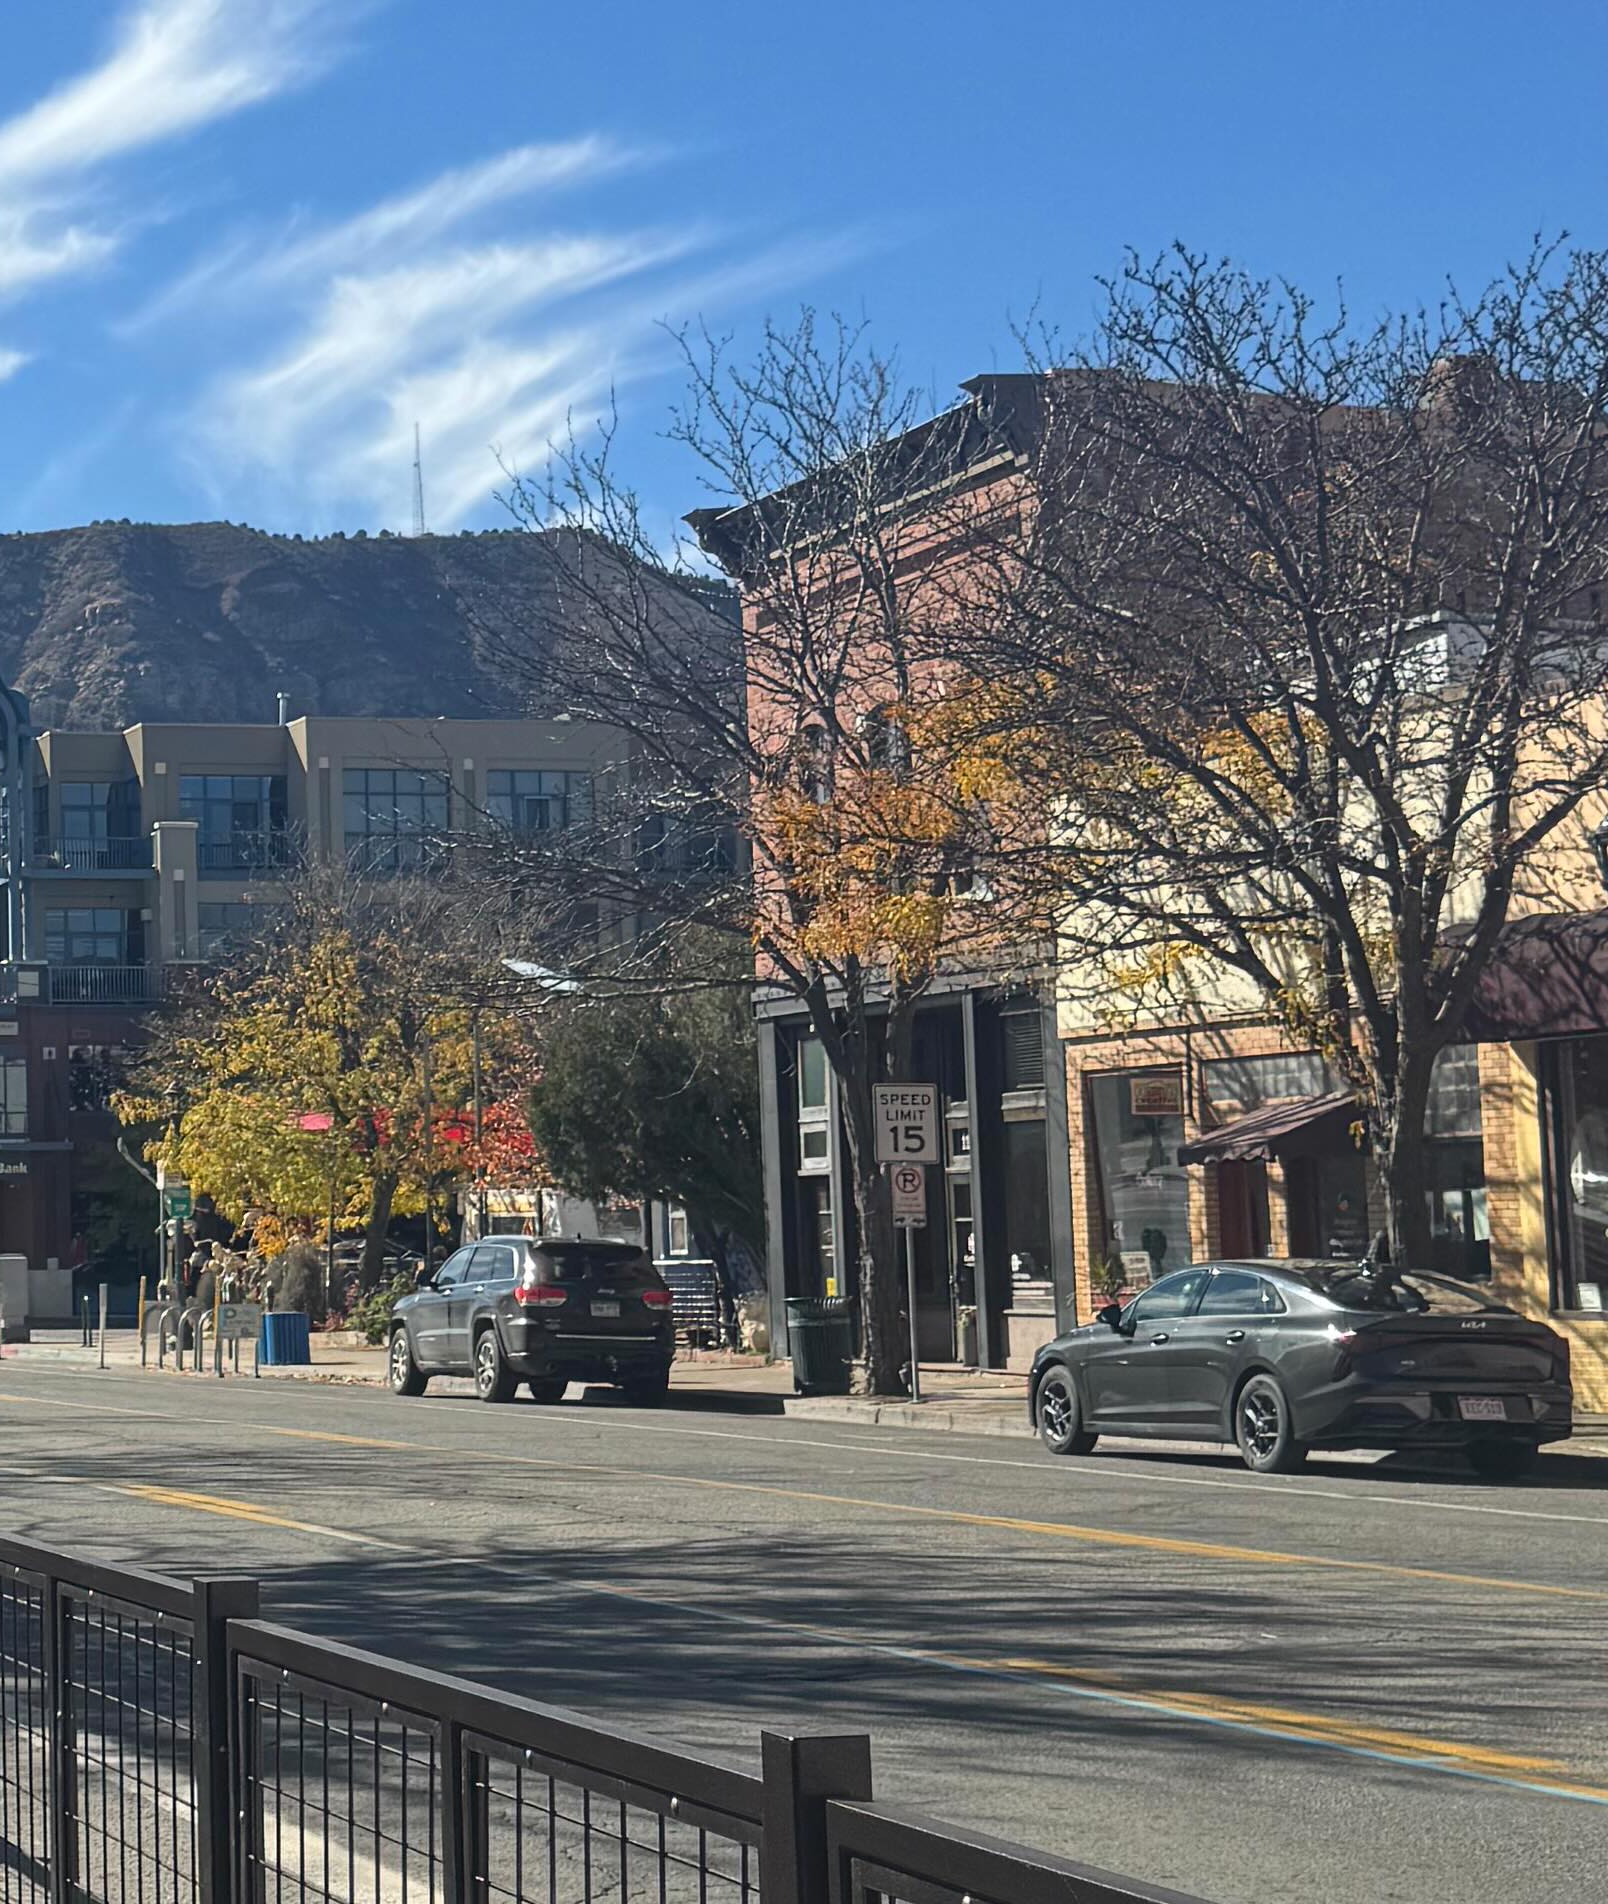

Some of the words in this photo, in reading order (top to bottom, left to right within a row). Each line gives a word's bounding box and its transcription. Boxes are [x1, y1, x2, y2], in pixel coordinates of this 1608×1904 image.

[879, 1094, 931, 1106] SPEED
[886, 1109, 926, 1121] LIMIT
[889, 1125, 925, 1153] 15
